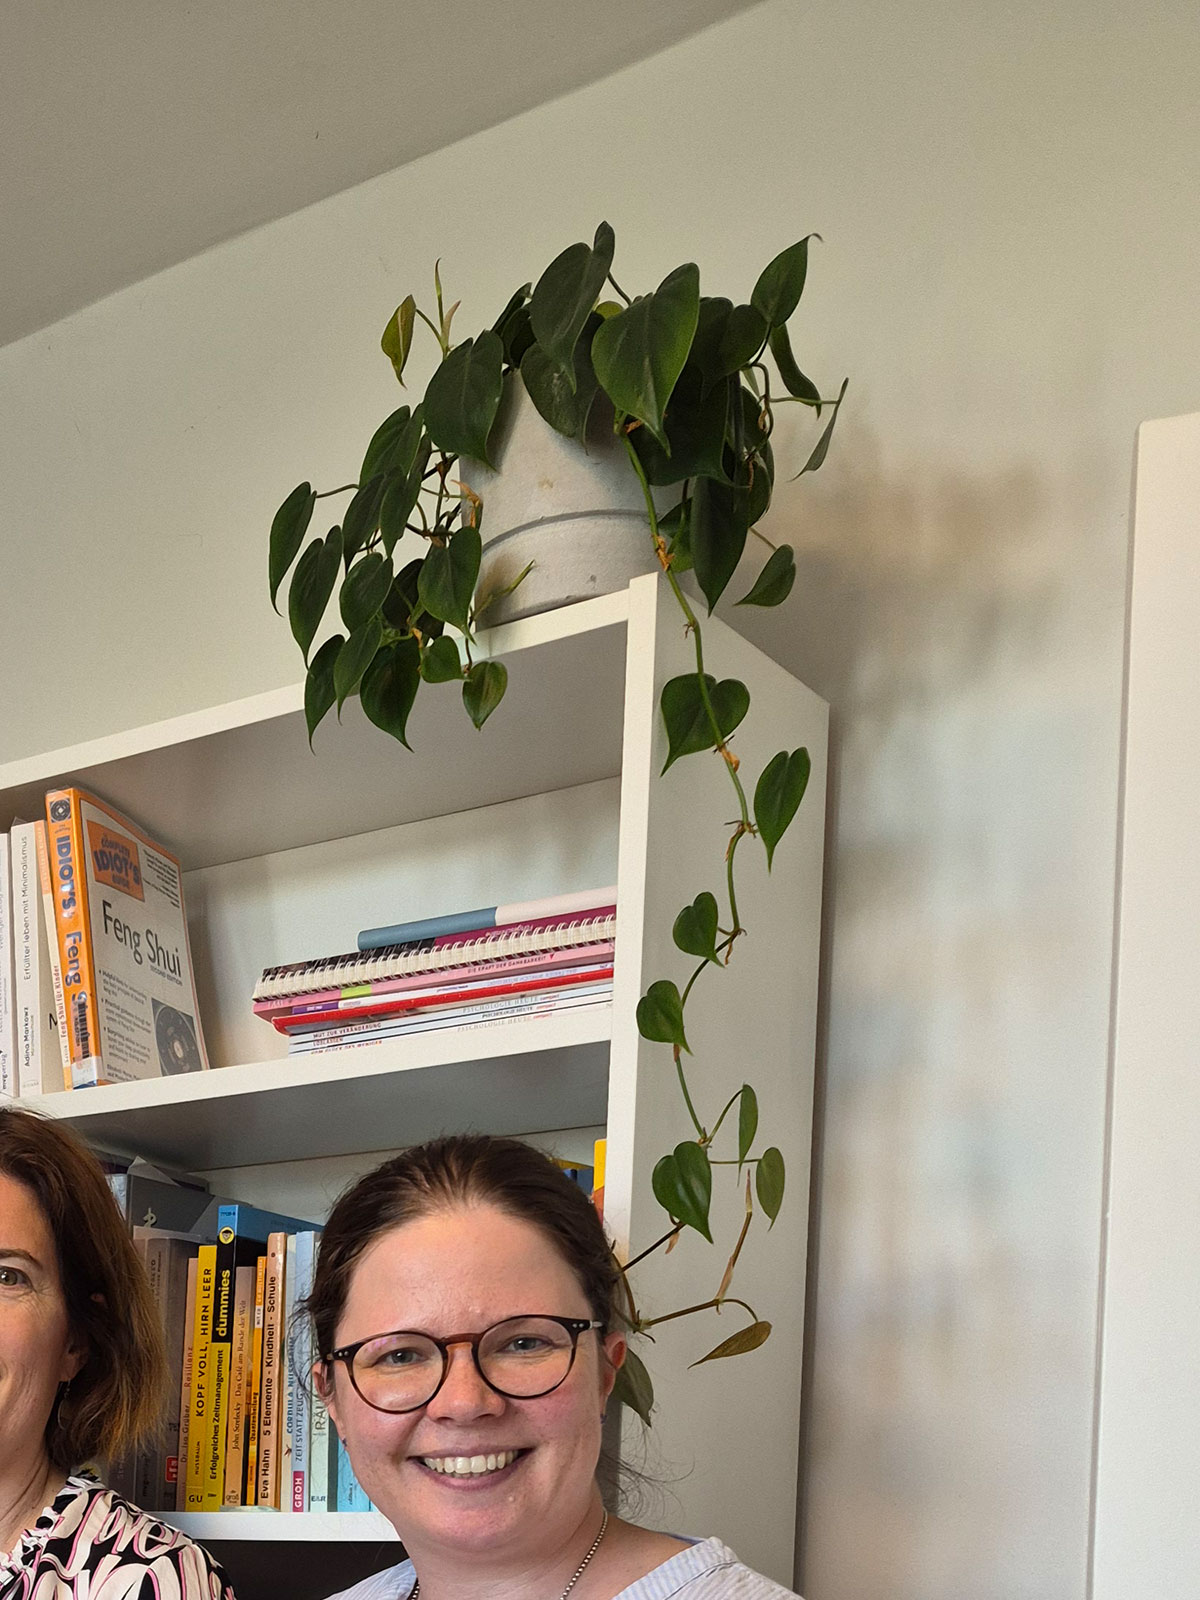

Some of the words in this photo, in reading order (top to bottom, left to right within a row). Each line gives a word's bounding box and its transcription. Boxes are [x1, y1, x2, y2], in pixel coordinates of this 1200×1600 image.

[20, 836, 29, 898] Minimalismus
[102, 899, 143, 966] Feng
[145, 928, 182, 978] Shui
[23, 945, 31, 980] Erfüllter
[64, 931, 83, 986] Feng
[53, 965, 61, 989] Kinder
[202, 1268, 212, 1299] LEER
[267, 1276, 277, 1312] Schule
[200, 1305, 210, 1336] HIRN
[215, 1269, 231, 1337] dummies
[197, 1341, 209, 1378] VOLL,
[265, 1323, 275, 1367] Kindheit
[195, 1383, 206, 1417] KOPF
[212, 1349, 224, 1423] Zeitmanagement
[263, 1378, 273, 1426] Elemente
[232, 1403, 242, 1438] Strelecky
[295, 1392, 304, 1417] ZEUG
[295, 1418, 303, 1442] STATT
[209, 1424, 220, 1480] Erfolgreiches
[261, 1448, 271, 1477] Hahn
[295, 1444, 303, 1462] ZEIT
[188, 1494, 203, 1503] GU
[260, 1482, 269, 1498] Eva
[294, 1477, 303, 1508] GROH
